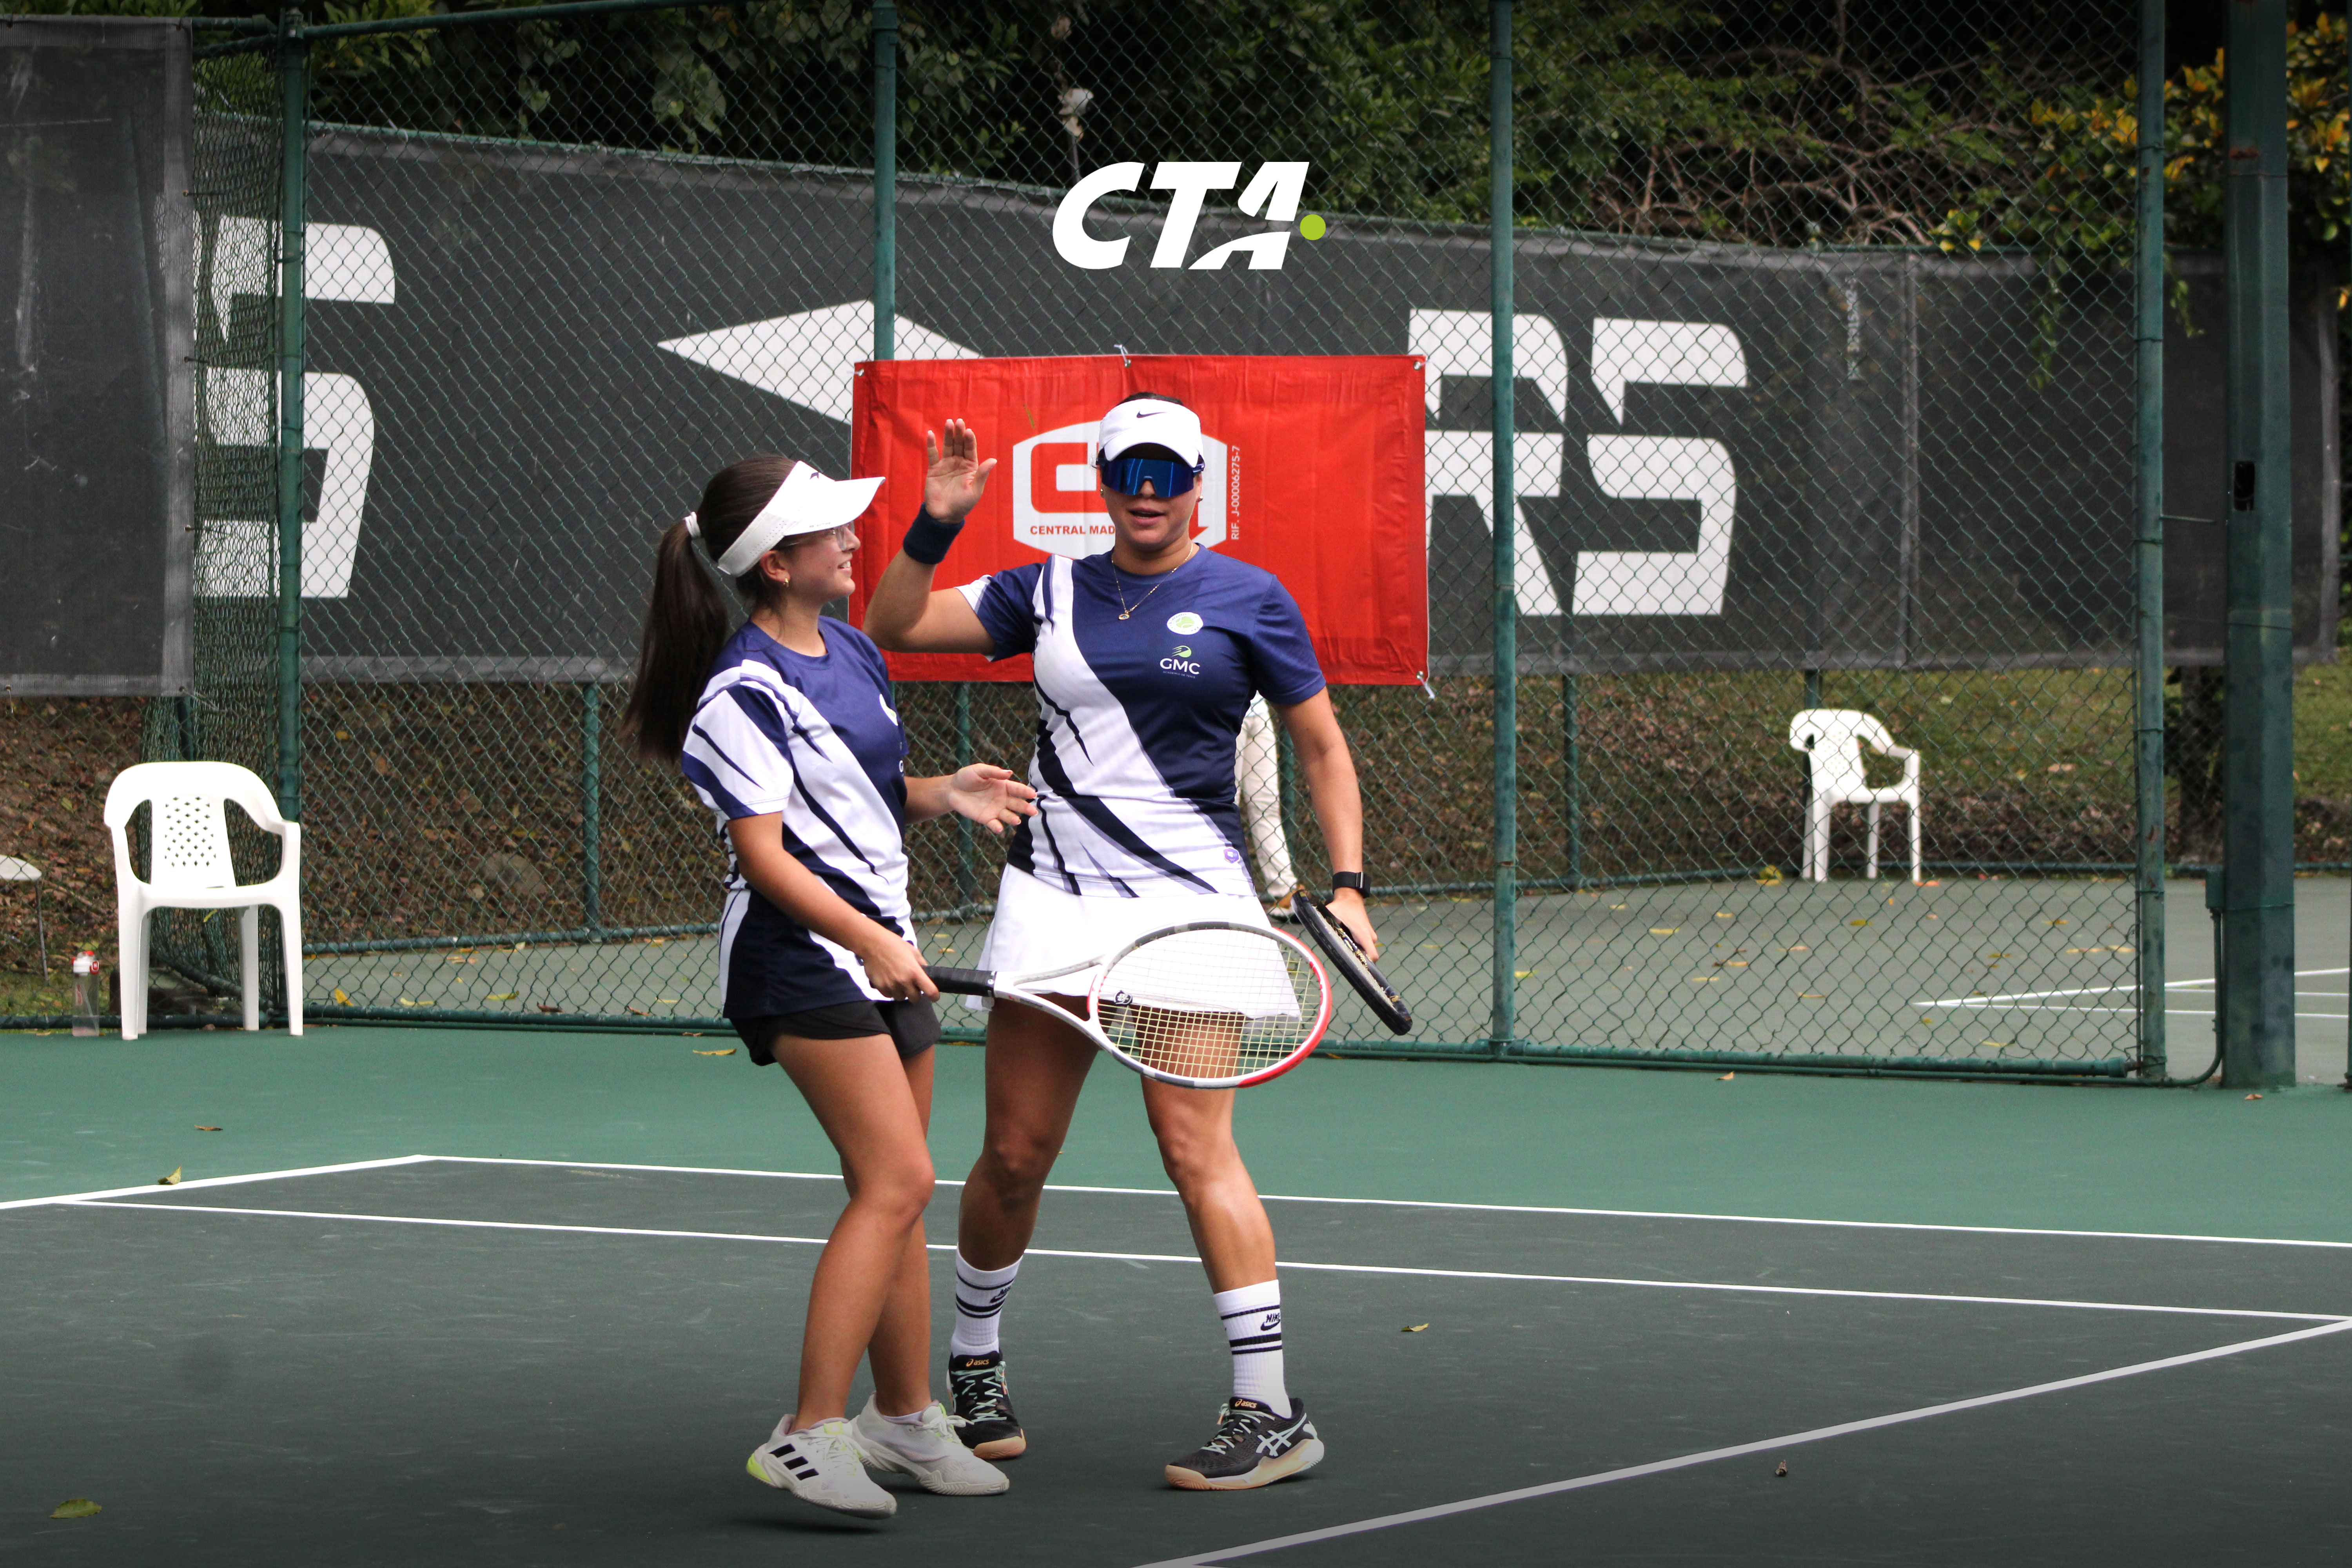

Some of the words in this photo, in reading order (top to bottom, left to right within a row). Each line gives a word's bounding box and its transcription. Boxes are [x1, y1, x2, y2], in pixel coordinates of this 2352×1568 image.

[1231, 445, 1240, 517] J-00006275-7
[1030, 525, 1086, 535] CENTRAL
[1089, 525, 1115, 534] MAD
[1231, 520, 1240, 540] RIF.
[1160, 658, 1200, 675] GMC
